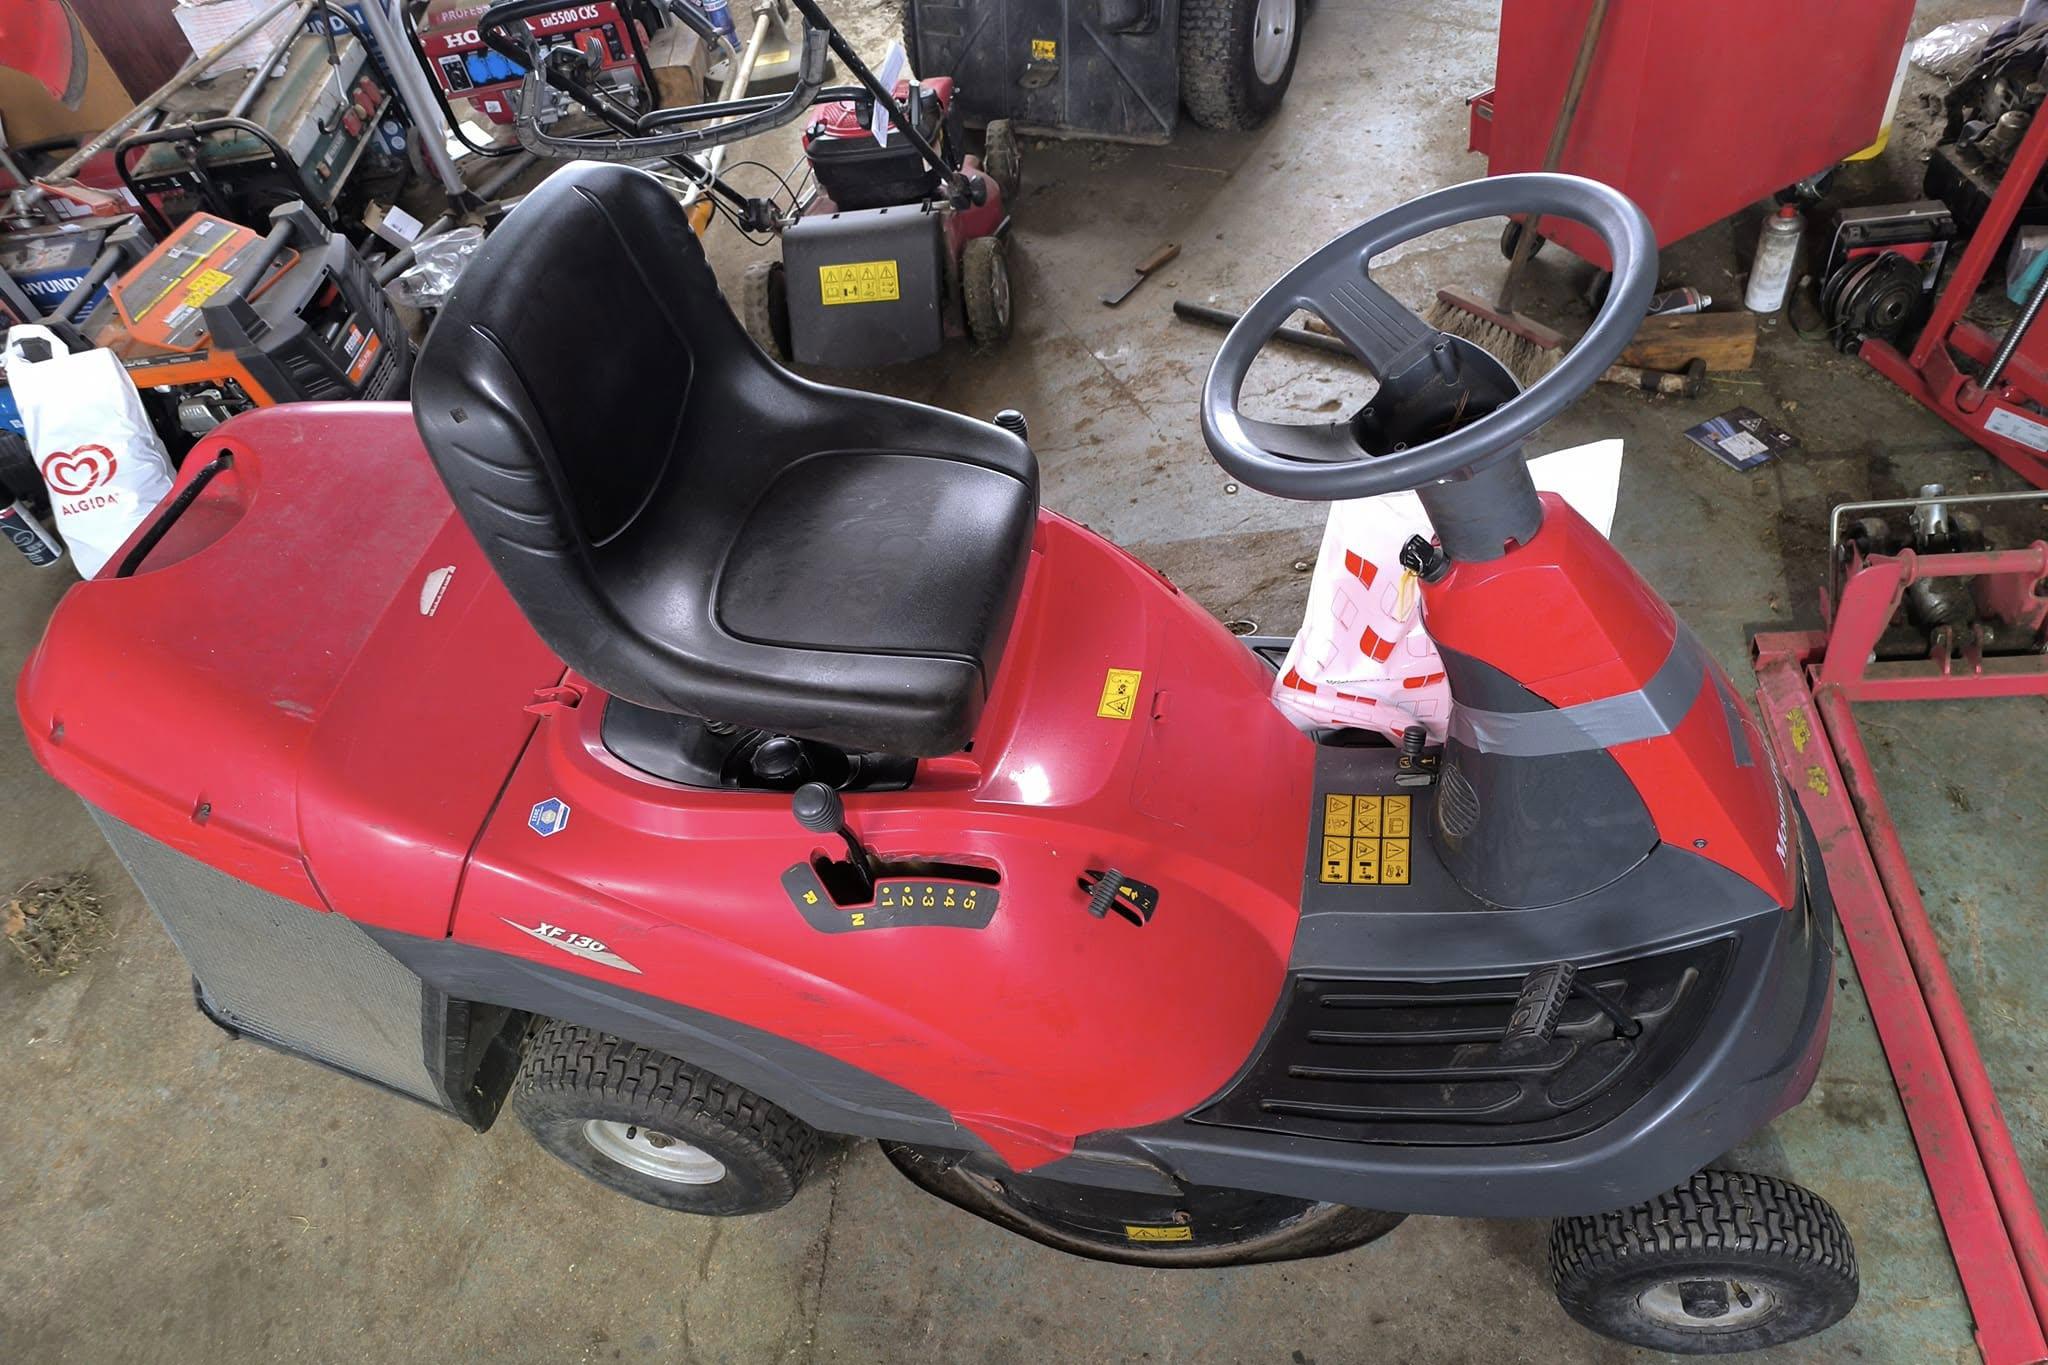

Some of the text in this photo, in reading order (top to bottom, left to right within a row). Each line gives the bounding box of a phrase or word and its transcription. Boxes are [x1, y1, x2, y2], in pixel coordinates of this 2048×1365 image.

[578, 4, 599, 20] CXS
[62, 494, 119, 516] ALGIDA
[802, 890, 818, 905] R
[882, 895, 976, 911] 1 2 3 4 5
[851, 912, 865, 927] N
[532, 922, 606, 952] XF 130
